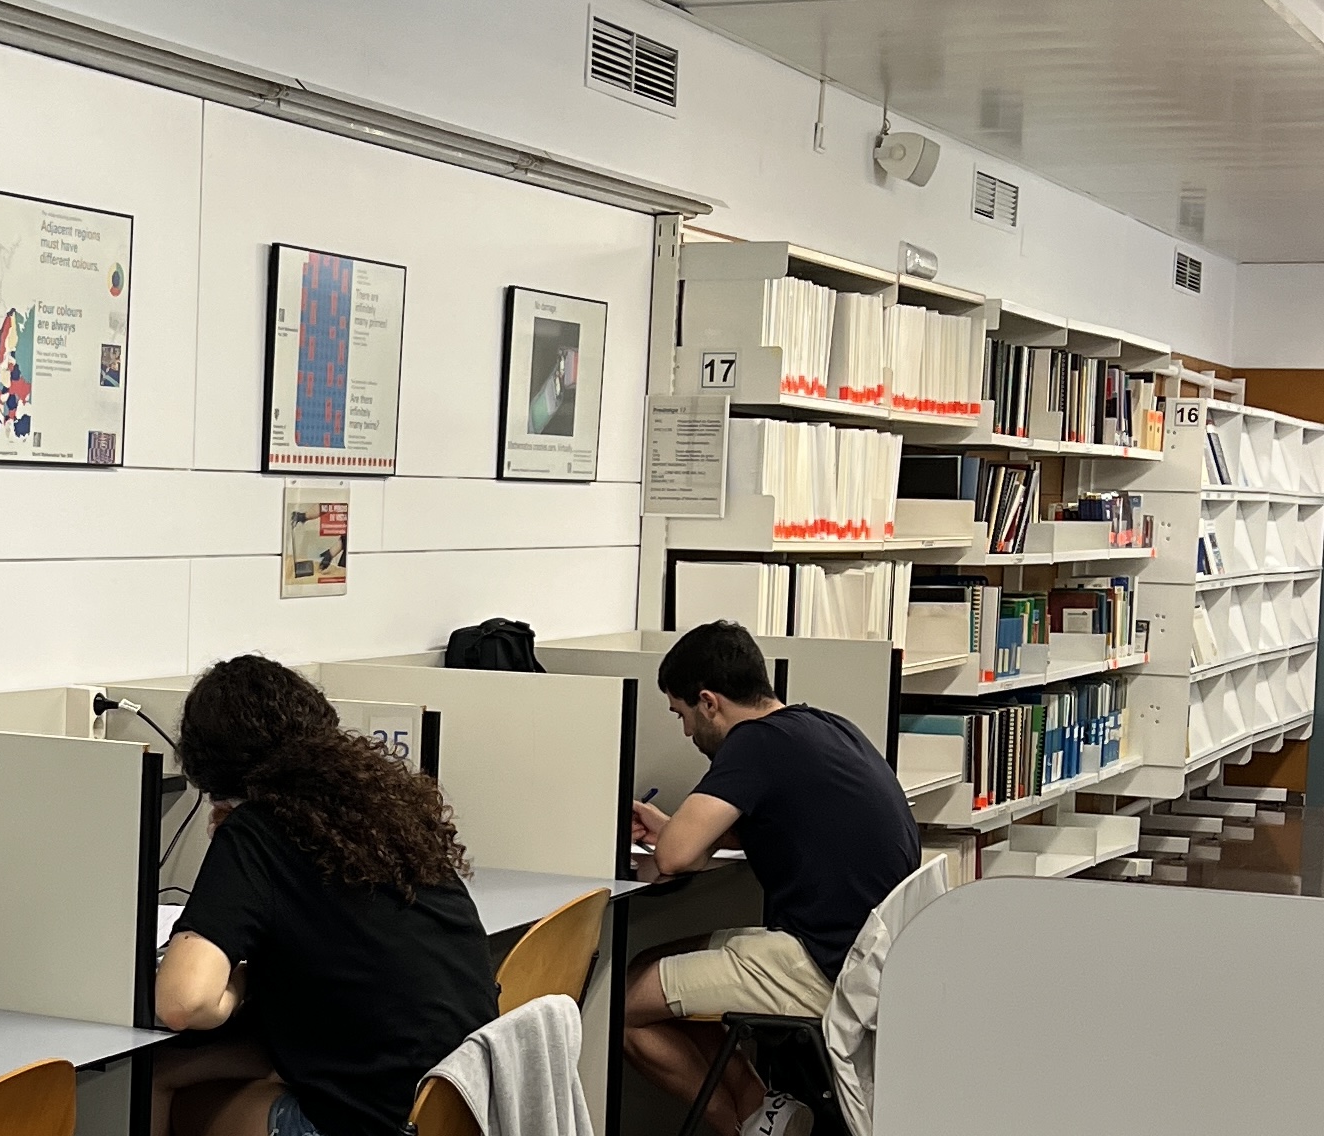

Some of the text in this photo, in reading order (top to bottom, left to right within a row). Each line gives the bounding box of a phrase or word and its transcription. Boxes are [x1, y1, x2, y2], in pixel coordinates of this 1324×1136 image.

[41, 239, 59, 250] must
[38, 301, 55, 314] Four
[704, 359, 735, 382] 17
[1177, 407, 1199, 423] 16
